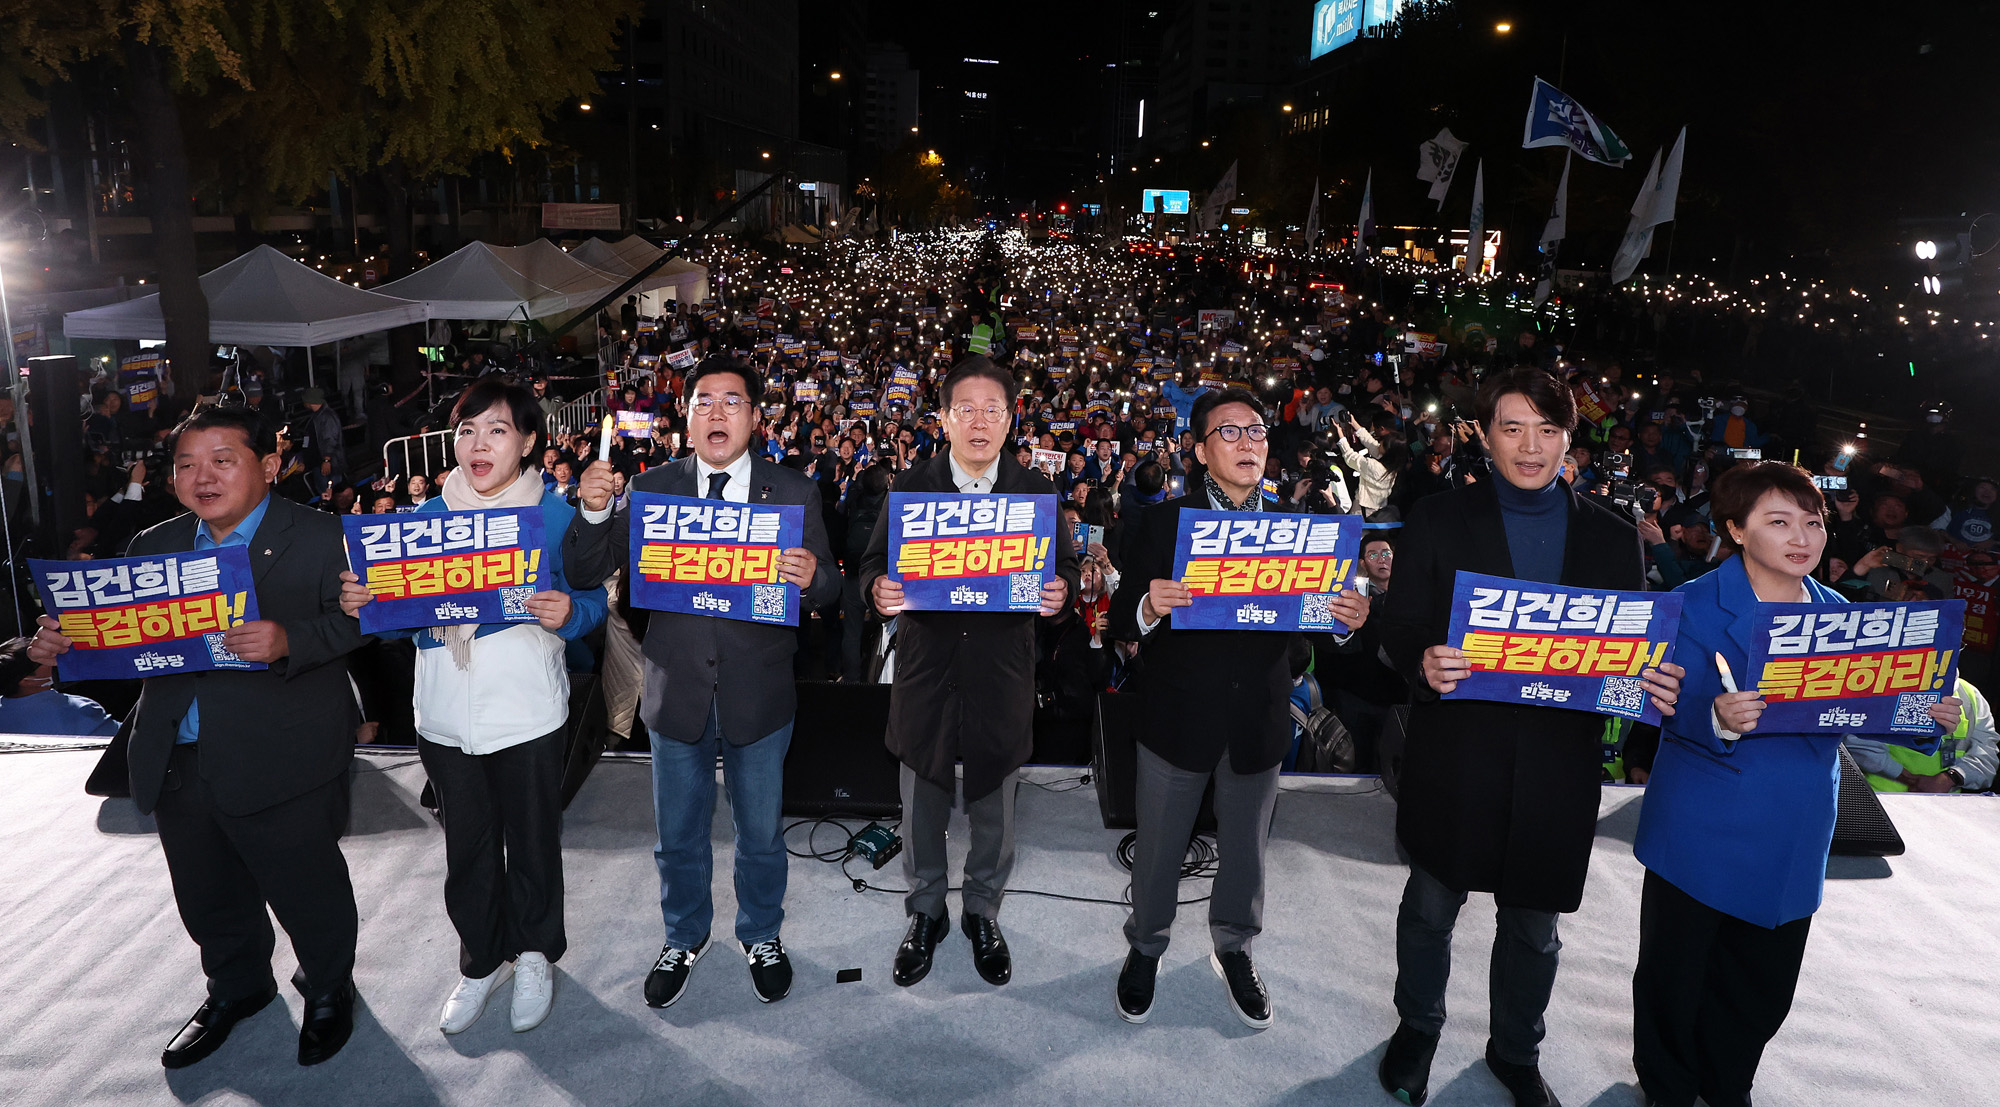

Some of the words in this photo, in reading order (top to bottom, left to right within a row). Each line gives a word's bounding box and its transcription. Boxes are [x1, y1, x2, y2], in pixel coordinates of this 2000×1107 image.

[361, 513, 520, 560] 김건희를
[642, 504, 781, 543] 김건희를
[901, 497, 1035, 537] 김건희를
[1190, 517, 1340, 555] 김건희를
[365, 548, 541, 597] 특검하라!
[896, 536, 1051, 577] 특검하라!
[1180, 558, 1352, 594] 특검하라!
[46, 556, 220, 607] 김건희를
[950, 590, 988, 605] 민주당
[58, 591, 247, 648] 특검하라!
[435, 606, 479, 619] 민주당
[692, 596, 731, 613] 민주당
[1236, 608, 1278, 624] 민주당
[1468, 587, 1654, 635] 김건희를
[1768, 606, 1939, 655] 김건희를
[134, 654, 184, 672] 민주당
[1461, 632, 1669, 676] 특검하라!
[1520, 685, 1571, 703] 민주당
[1757, 649, 1953, 700] 특검하라!
[1818, 712, 1867, 727] 민주당
